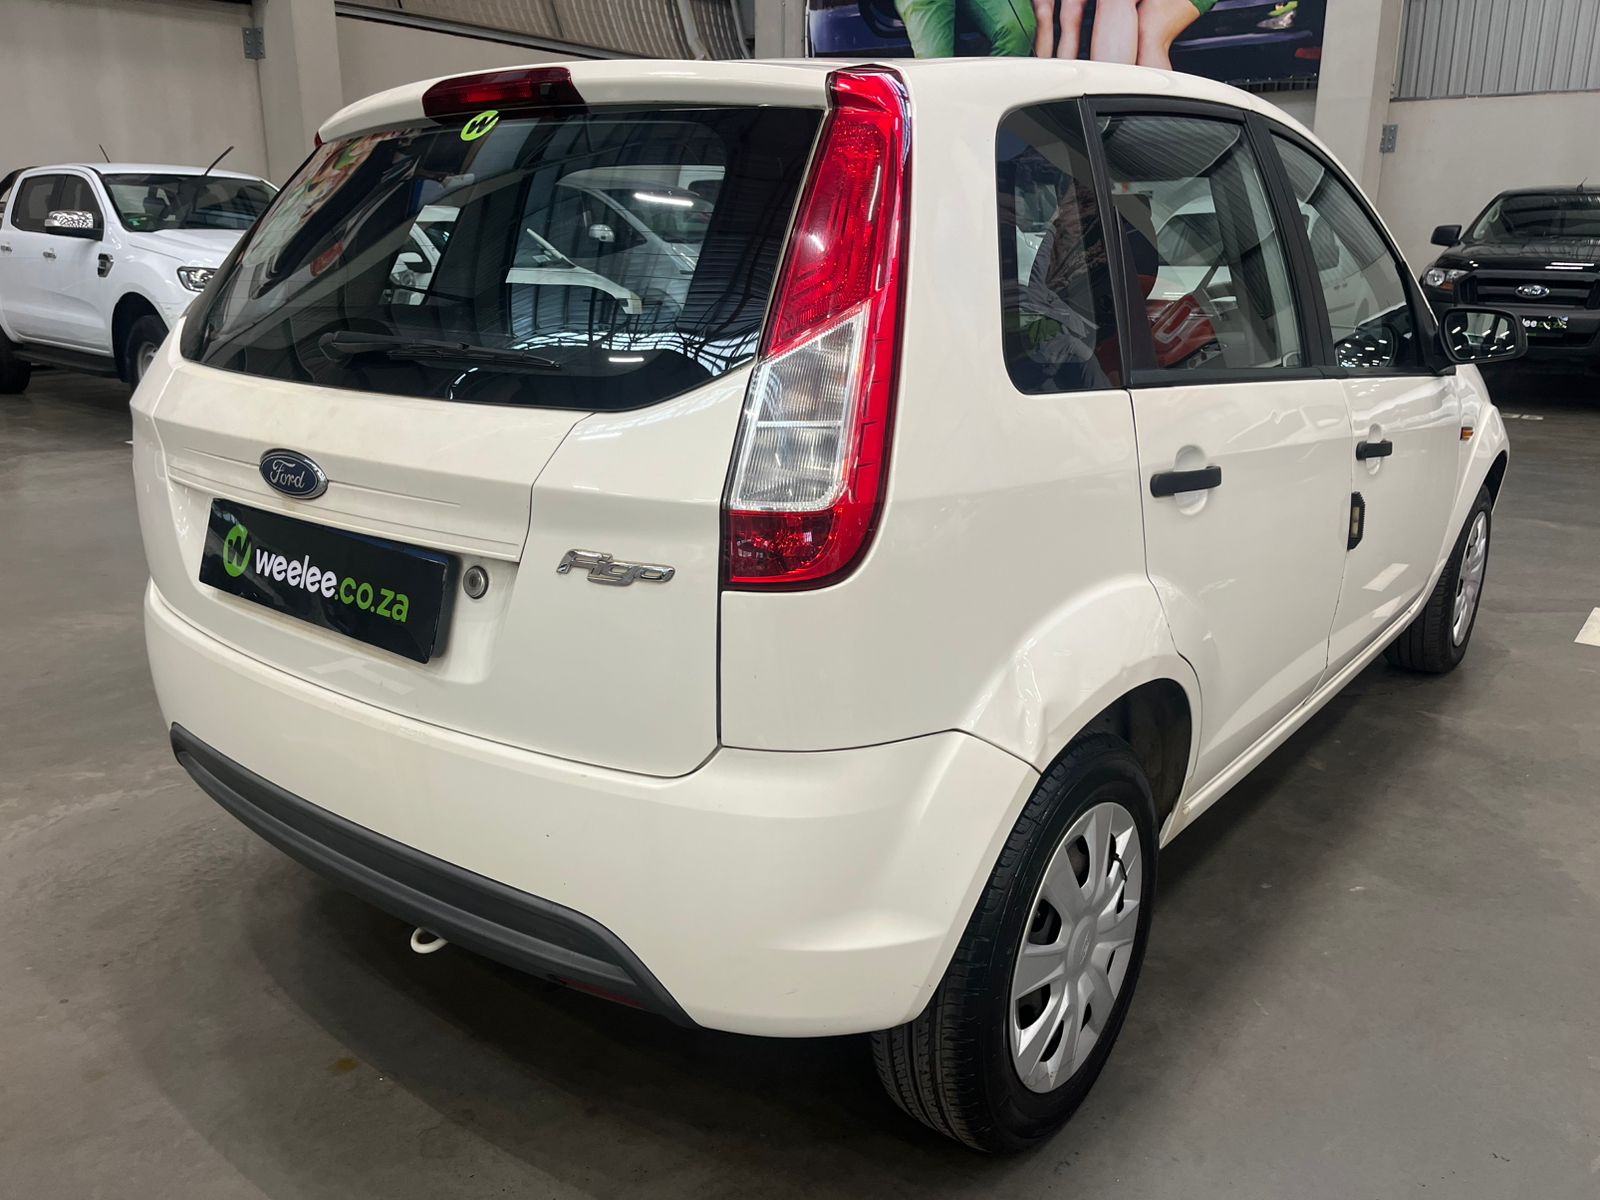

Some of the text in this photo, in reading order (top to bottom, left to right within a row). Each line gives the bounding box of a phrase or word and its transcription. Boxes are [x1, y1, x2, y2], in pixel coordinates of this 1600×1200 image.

[269, 459, 306, 489] Ford
[255, 548, 410, 622] weelee.co.za
[556, 548, 676, 587] Figo
